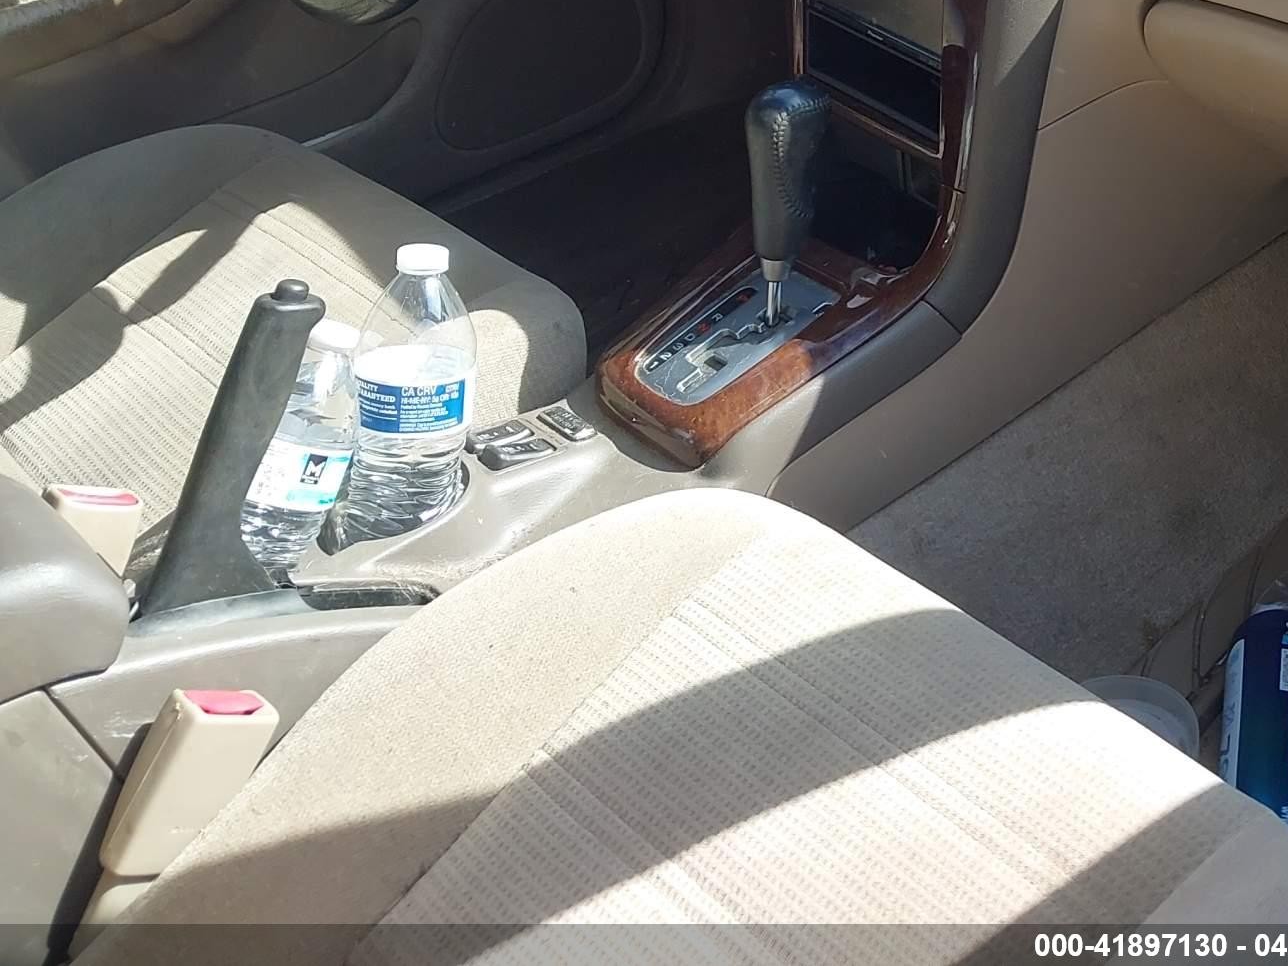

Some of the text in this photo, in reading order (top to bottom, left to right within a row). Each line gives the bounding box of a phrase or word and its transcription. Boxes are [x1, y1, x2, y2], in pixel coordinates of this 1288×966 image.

[711, 312, 723, 323] R
[685, 333, 696, 342] D
[672, 343, 684, 352] 3
[660, 352, 672, 361] 2
[649, 361, 658, 369] 1
[358, 381, 379, 392] ALITY
[401, 386, 415, 396] CA
[416, 385, 437, 396] CRV
[359, 389, 396, 403] ARANTEED
